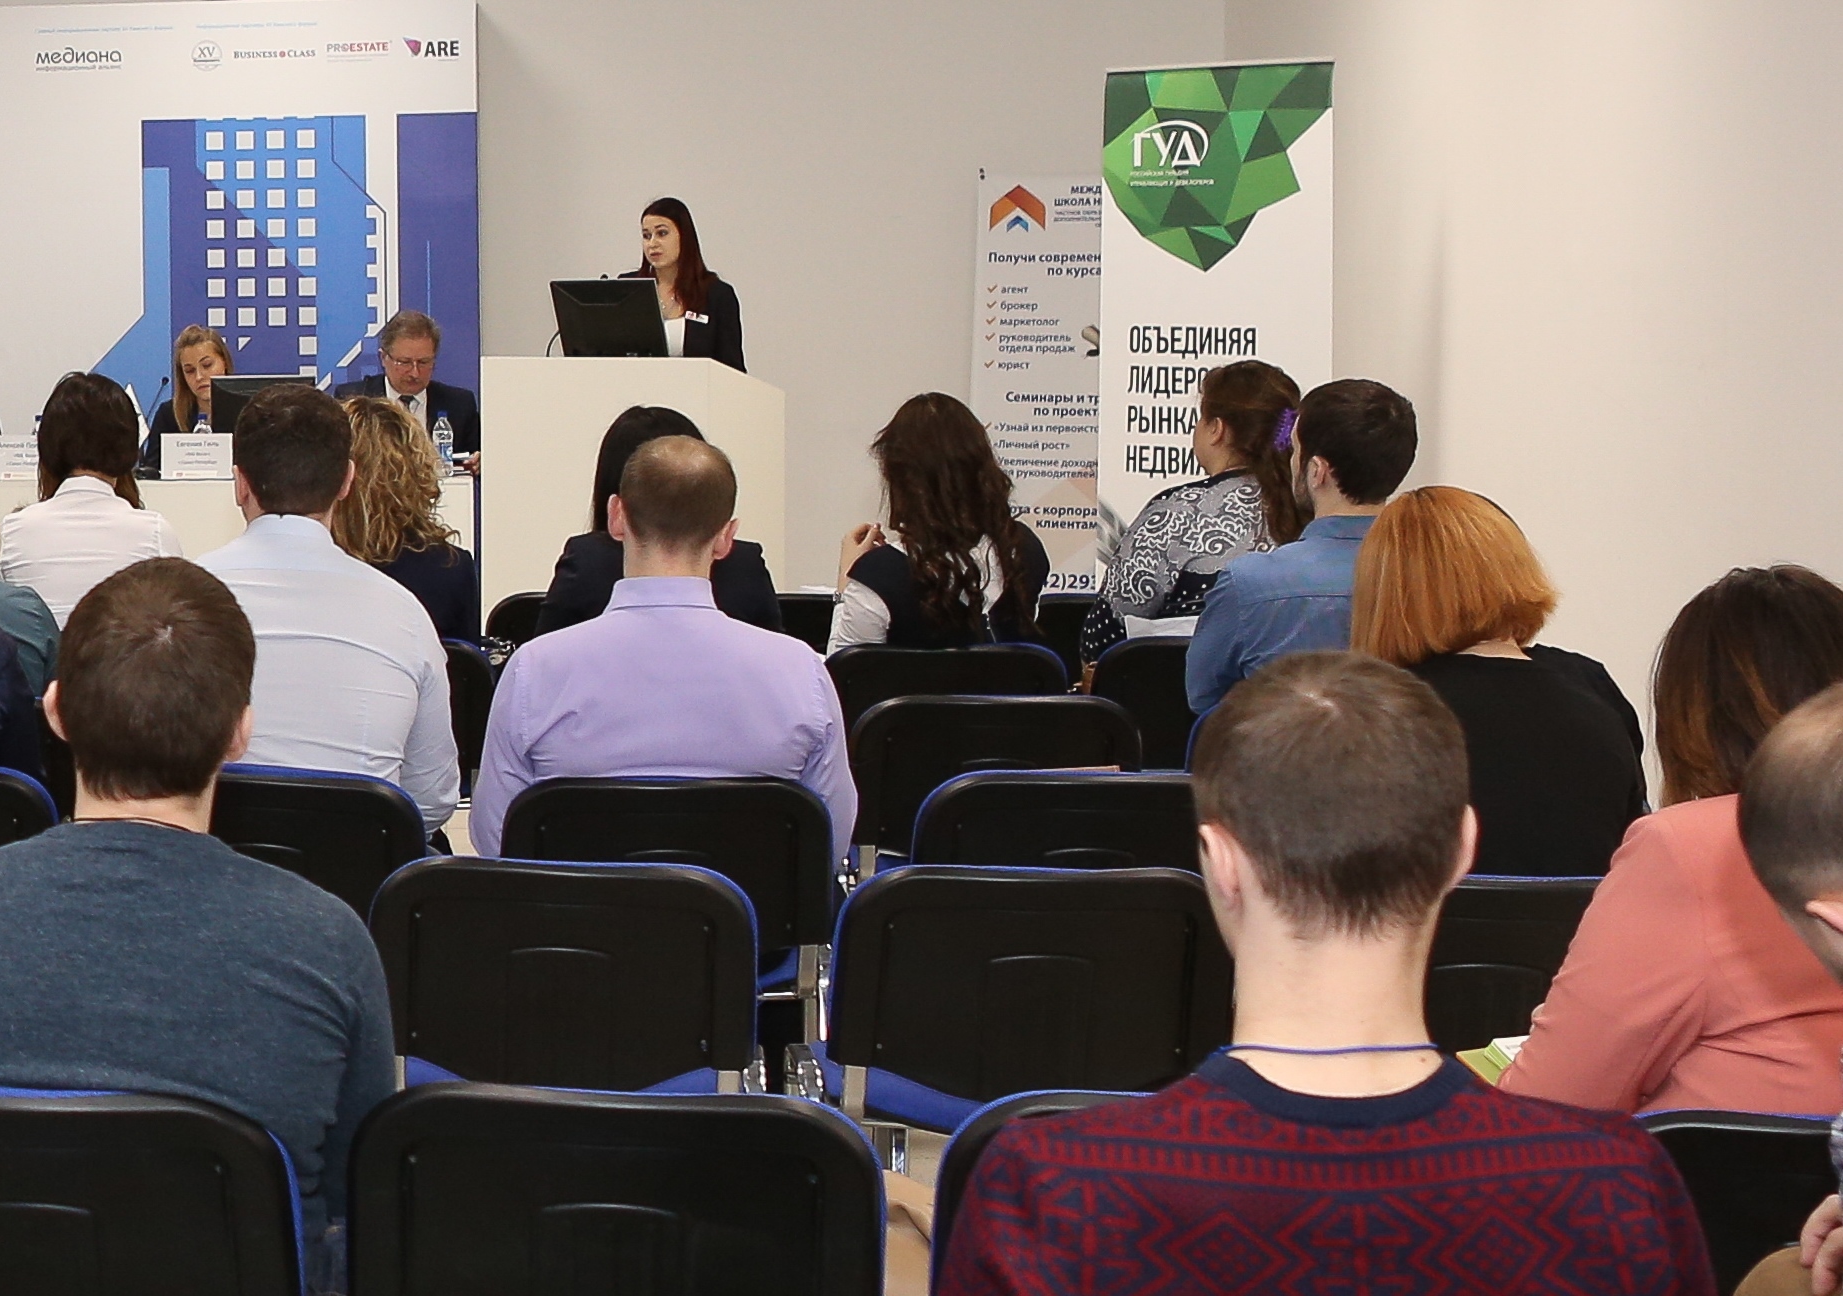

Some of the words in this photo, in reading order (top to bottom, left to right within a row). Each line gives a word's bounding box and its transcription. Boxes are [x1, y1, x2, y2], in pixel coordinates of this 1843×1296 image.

[424, 41, 459, 57] ARE
[35, 47, 123, 65] медиана
[1133, 128, 1202, 168] ГУД
[1054, 197, 1091, 206] ШКОЛА
[988, 252, 1036, 265] Получи
[1038, 253, 1102, 265] современ
[1047, 267, 1063, 276] по
[1001, 286, 1028, 294] агент
[1000, 301, 1038, 312] брокер
[999, 318, 1060, 327] маркетолог
[999, 334, 1072, 344] руководитель
[1129, 325, 1256, 359] ОБЪЕДИНЯЯ
[998, 344, 1034, 354] отдела
[1035, 345, 1076, 355] продаж
[998, 362, 1030, 371] юрист
[1005, 391, 1074, 406] Семинары
[1076, 394, 1085, 403] и
[1033, 407, 1049, 416] по
[1127, 405, 1199, 434] РЫНКА
[1031, 424, 1044, 432] из
[1041, 441, 1070, 452] рост»
[1125, 445, 1204, 479] НЕДВИ
[1033, 507, 1041, 515] с
[1042, 506, 1098, 518] корпора
